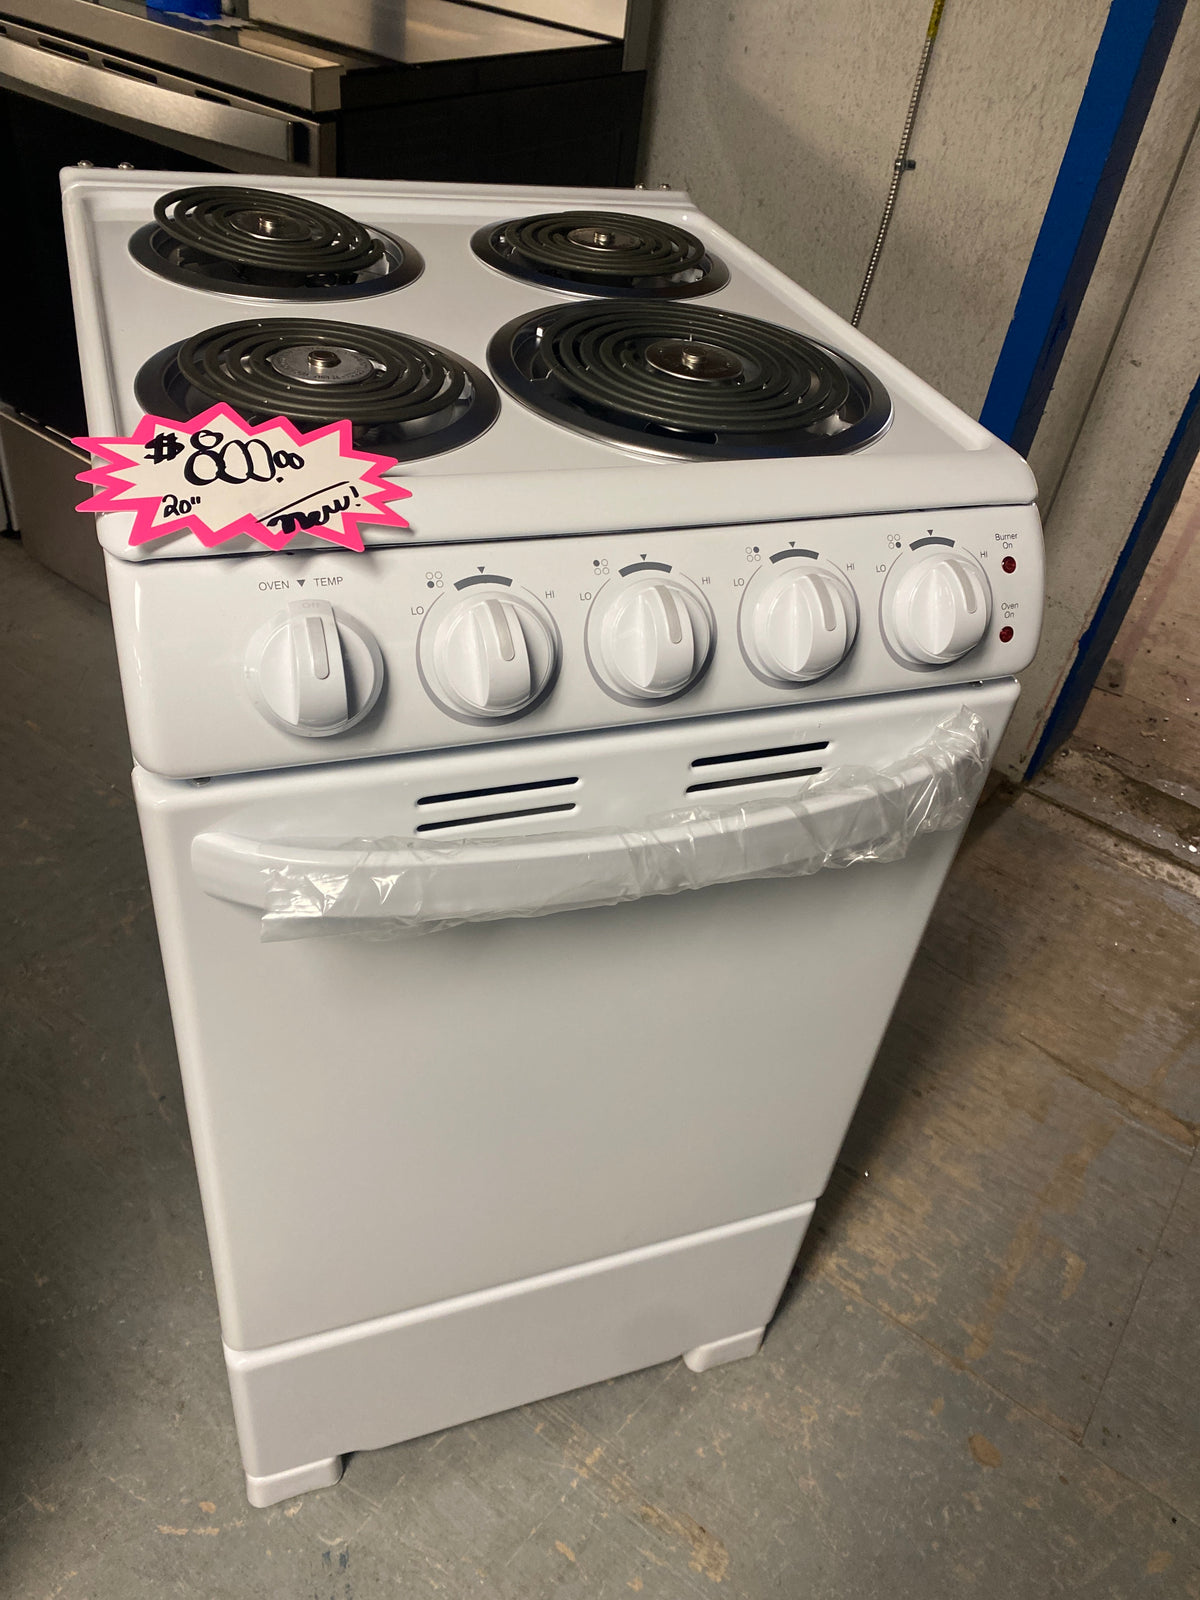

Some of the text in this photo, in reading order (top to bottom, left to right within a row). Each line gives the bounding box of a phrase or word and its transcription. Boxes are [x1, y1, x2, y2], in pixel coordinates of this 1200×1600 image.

[994, 533, 1018, 541] Burner
[1002, 541, 1013, 549] On
[875, 550, 989, 573] LO HI
[733, 563, 856, 587] LO HI
[258, 576, 344, 591] OVEN TEMP
[579, 576, 711, 601] LO HI
[411, 590, 555, 616] LO HI
[1001, 602, 1019, 610] Oven
[1004, 611, 1015, 619] On
